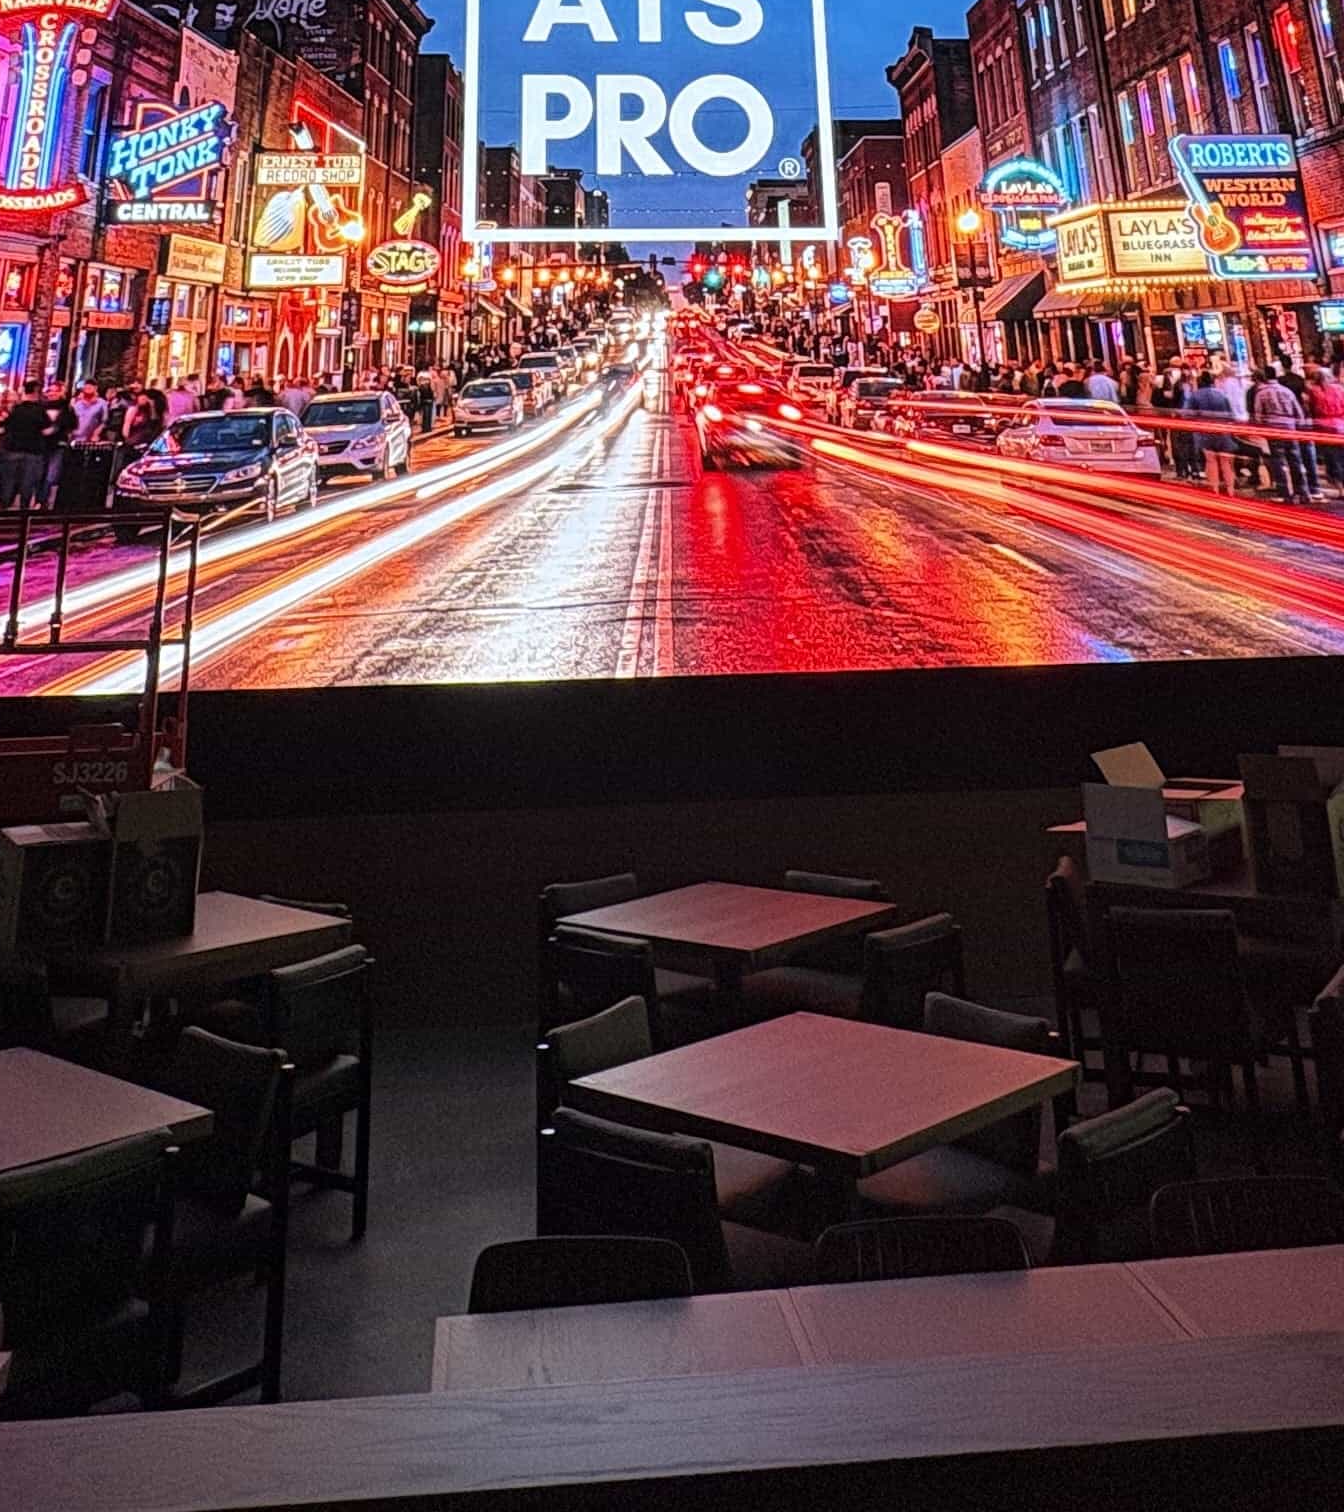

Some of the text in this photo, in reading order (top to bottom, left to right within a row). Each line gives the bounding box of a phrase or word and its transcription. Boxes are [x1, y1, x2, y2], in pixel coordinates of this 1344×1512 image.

[19, 13, 58, 189] CROSSROADS
[521, 74, 775, 177] PRO
[109, 104, 225, 176] HONKY
[262, 155, 361, 168] ERNEST TUBB
[1188, 143, 1291, 167] ROBERTS
[130, 136, 220, 199] TONK
[266, 170, 355, 182] RECORD SHOP
[1203, 178, 1296, 192] WESTERN
[1219, 193, 1286, 207] WORLD
[117, 203, 210, 221] CENTRAL
[1117, 218, 1195, 237] LAYLA'S
[1122, 239, 1196, 251] BLUEGRASS
[368, 248, 438, 275] STAGE
[1150, 253, 1172, 263] INN
[53, 761, 129, 785] SJ3226
